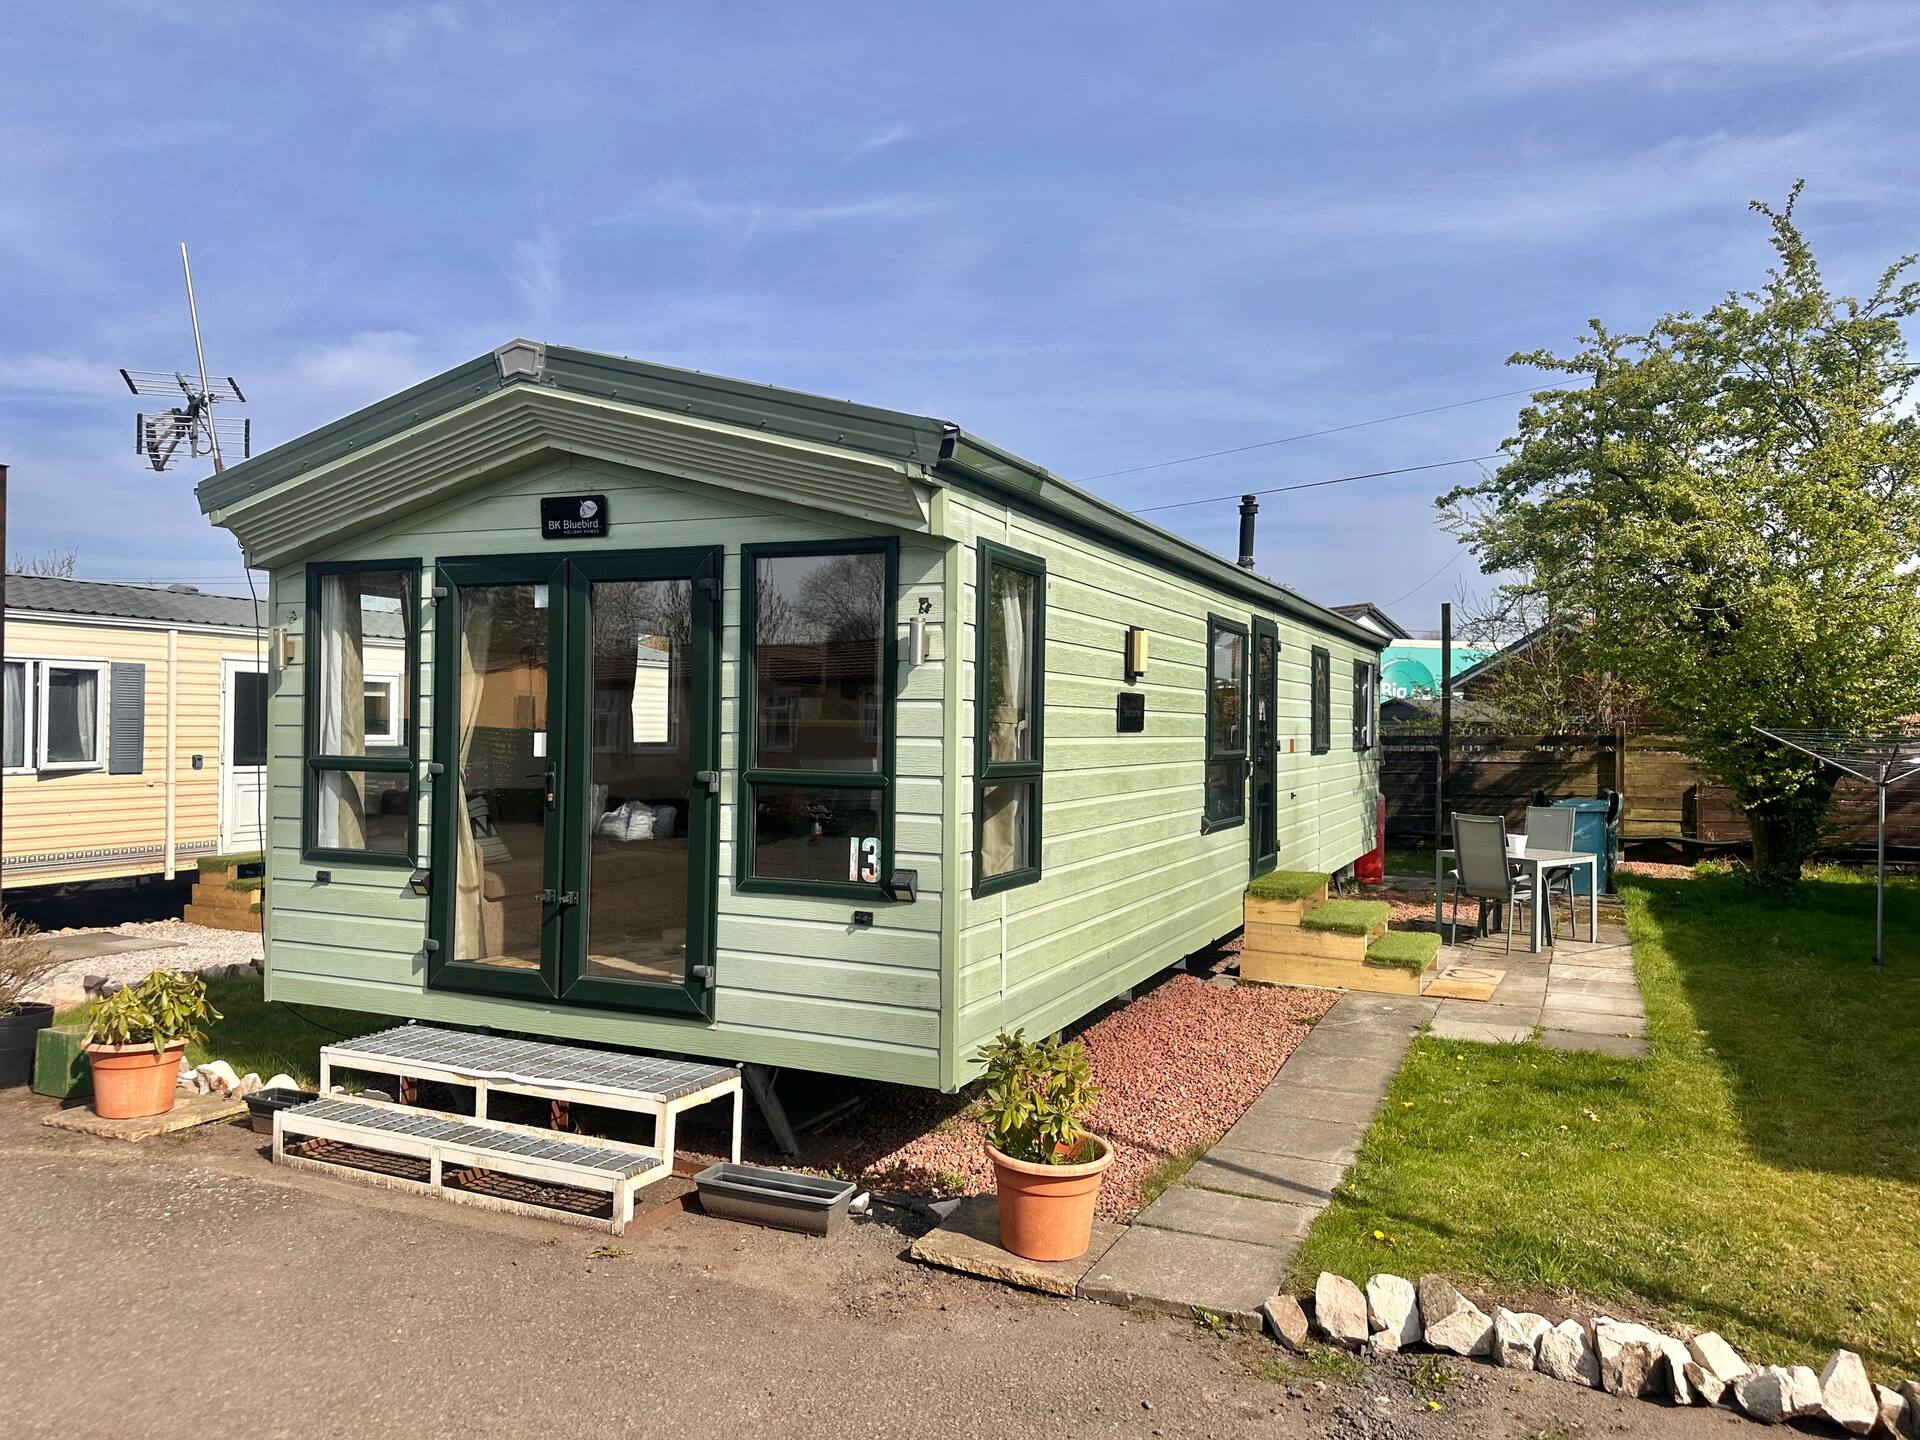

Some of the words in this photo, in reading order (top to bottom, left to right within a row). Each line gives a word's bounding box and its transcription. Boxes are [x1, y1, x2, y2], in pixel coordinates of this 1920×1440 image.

[548, 520, 561, 530] BK
[563, 518, 599, 529] Bluebird
[849, 836, 882, 884] 13
